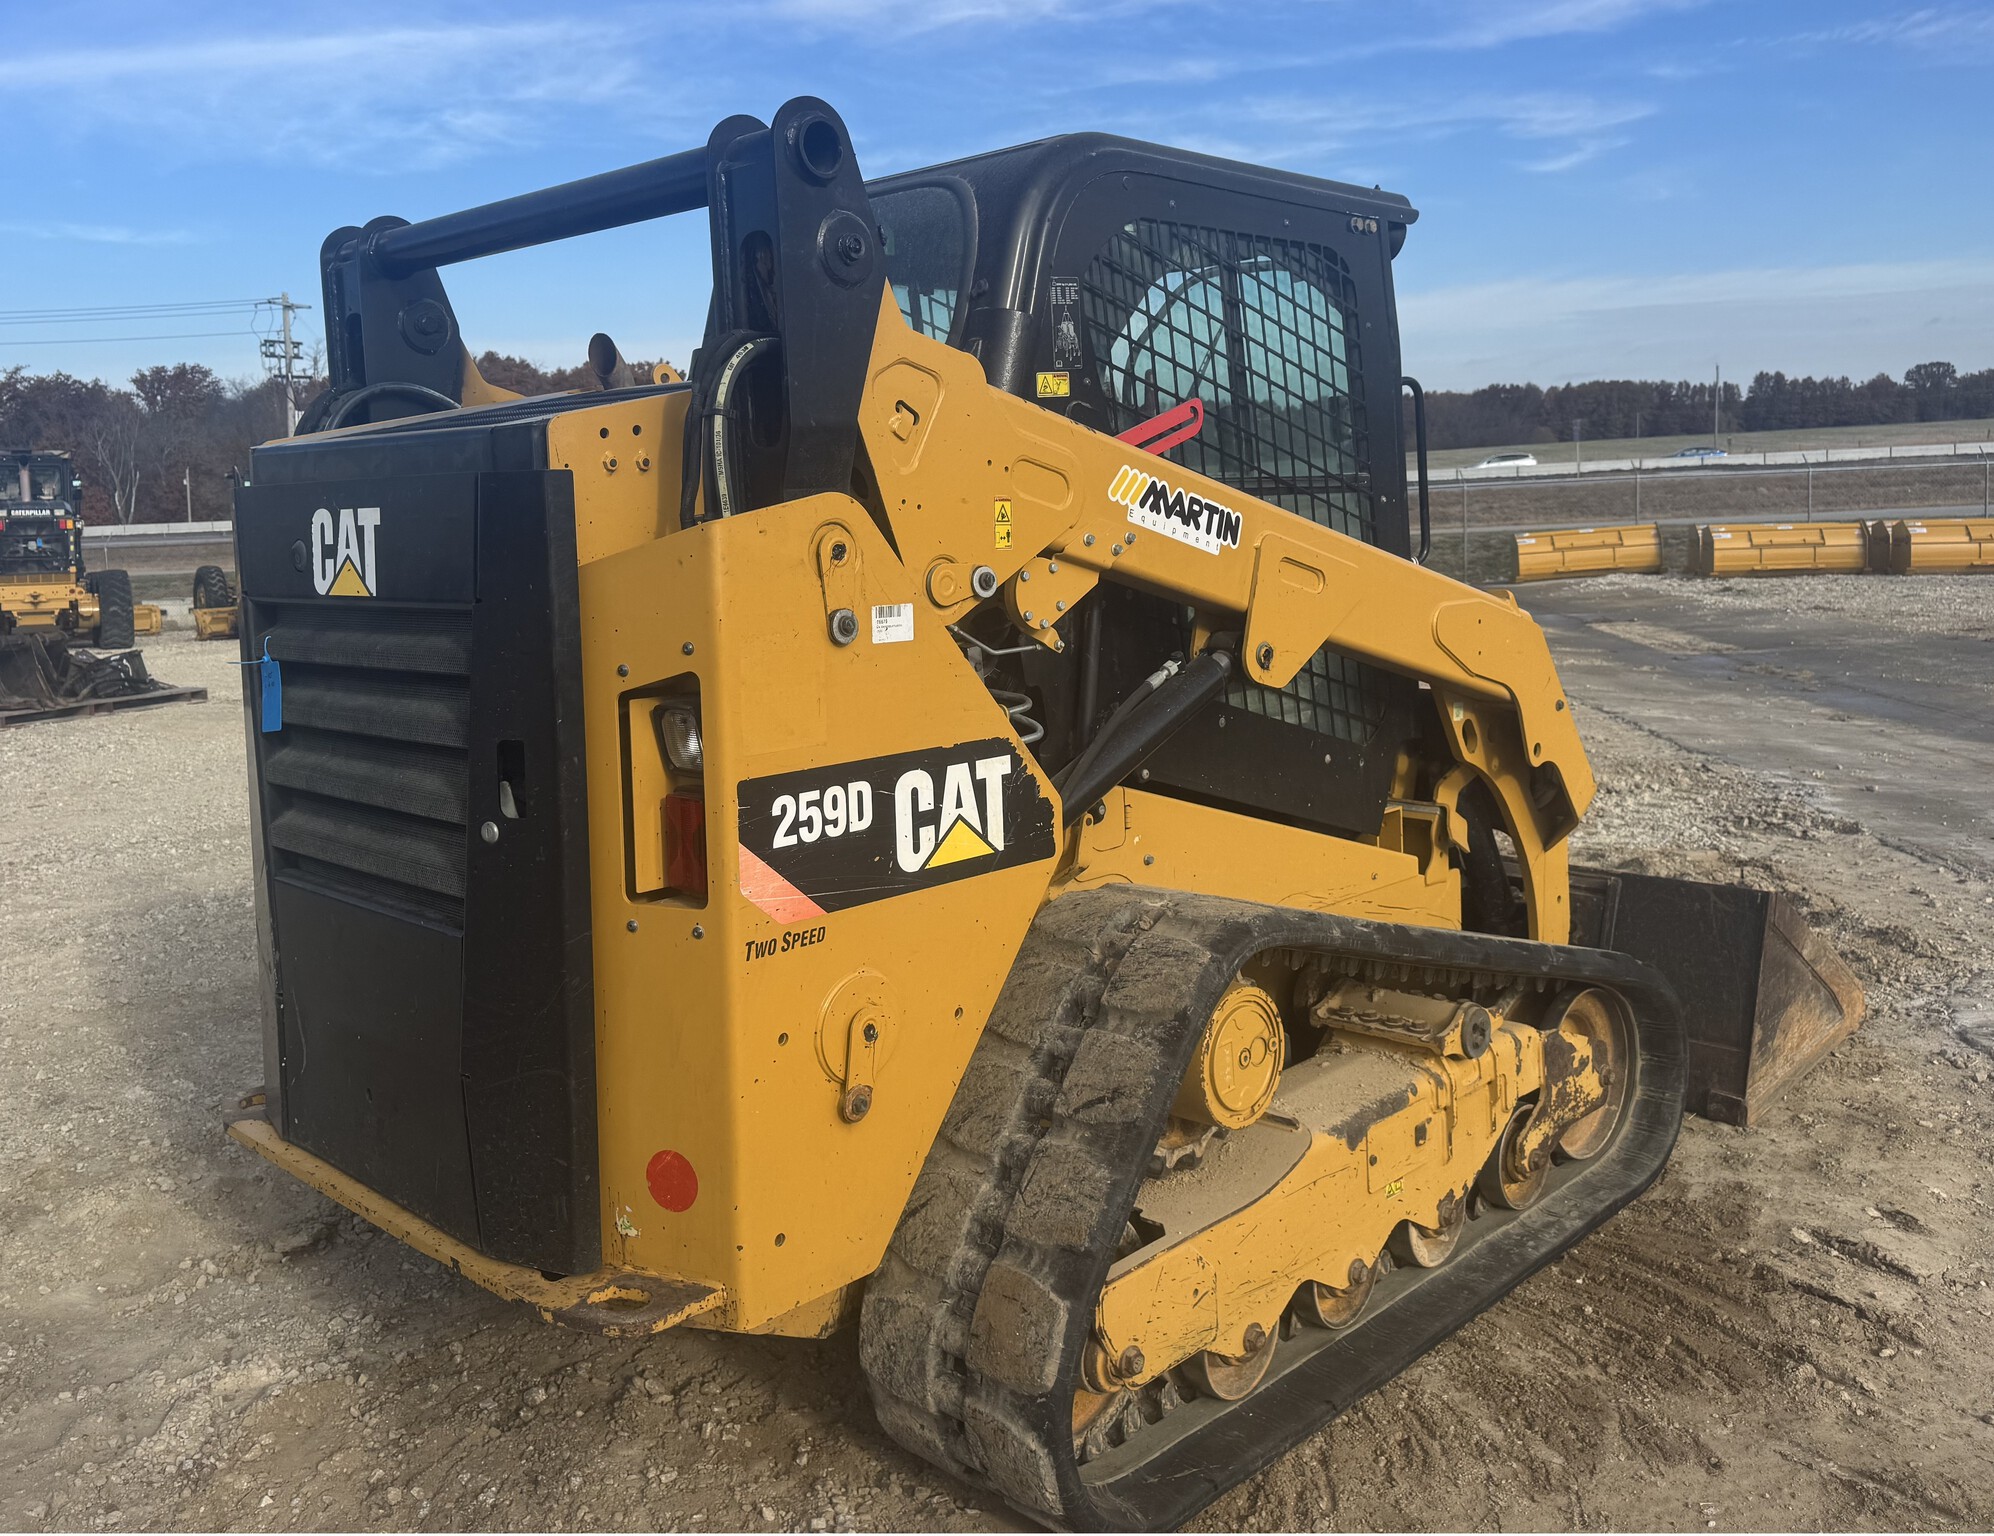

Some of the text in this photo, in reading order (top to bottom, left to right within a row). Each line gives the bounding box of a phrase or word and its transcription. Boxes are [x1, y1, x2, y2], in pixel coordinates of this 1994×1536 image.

[1128, 508, 1220, 551] Equipment
[1139, 480, 1241, 546] MARTIN
[311, 507, 381, 597] CAT
[771, 780, 873, 849] 259D
[894, 754, 1012, 873] CAT
